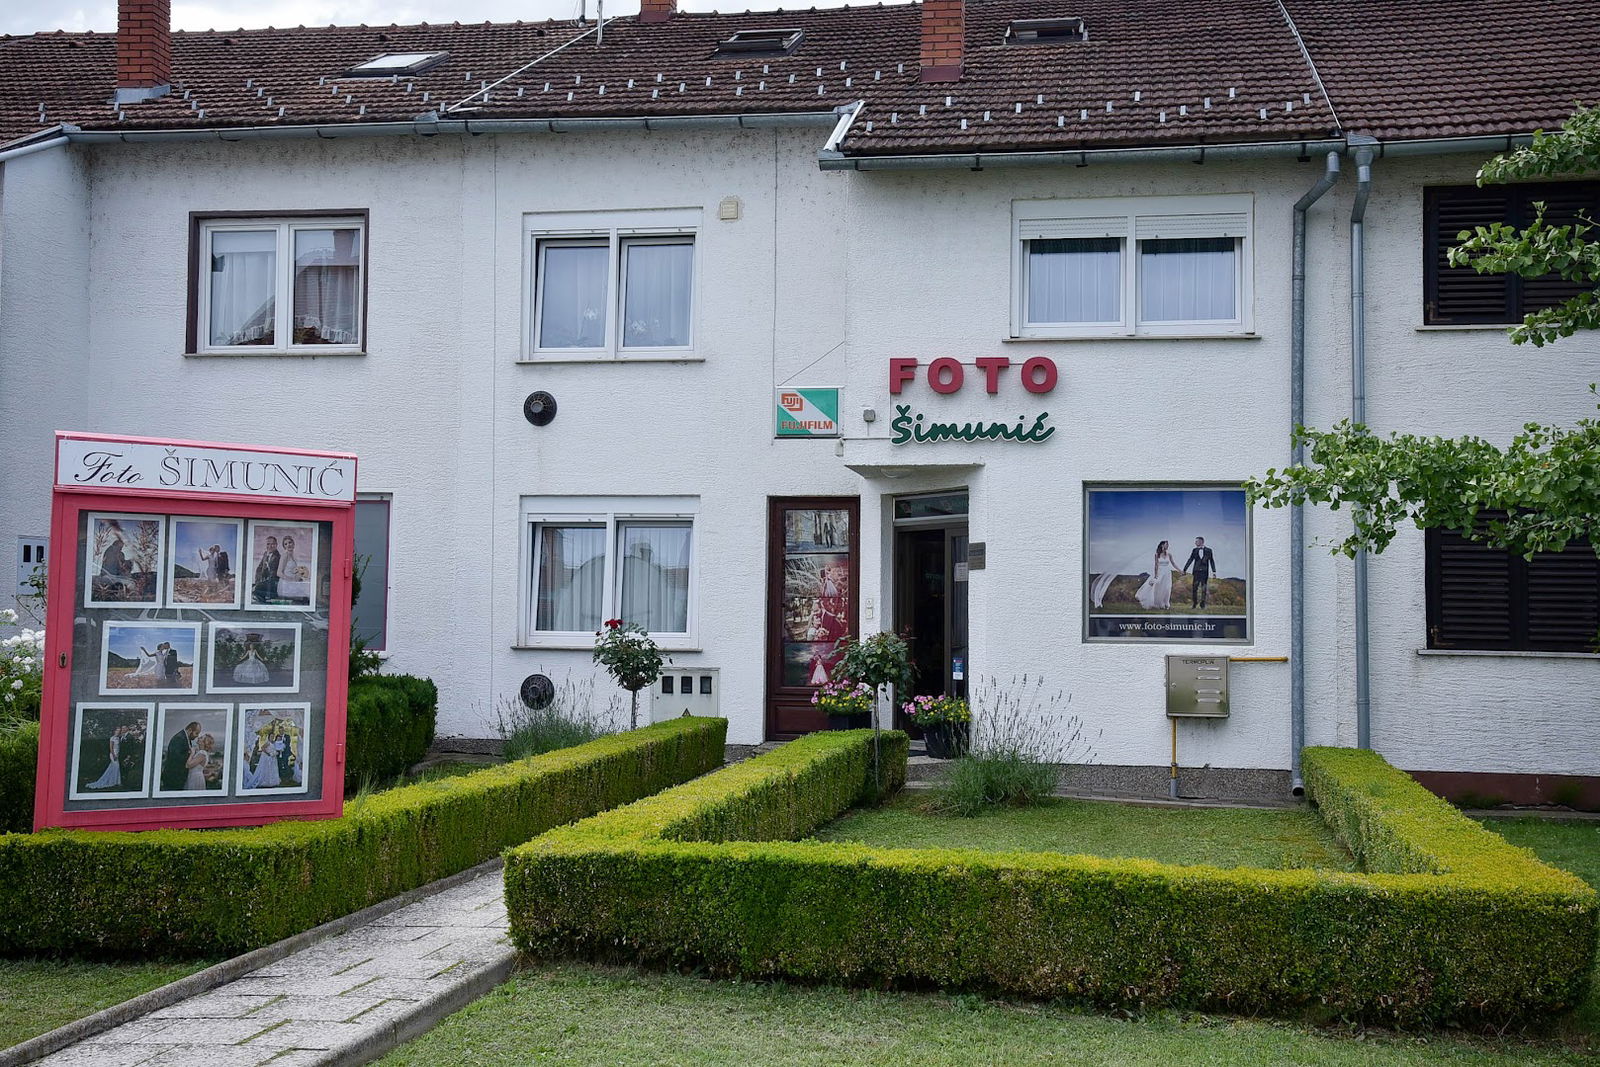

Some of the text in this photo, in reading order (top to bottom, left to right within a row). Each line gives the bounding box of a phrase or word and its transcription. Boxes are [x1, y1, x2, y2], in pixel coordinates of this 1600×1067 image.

[889, 356, 1058, 394] FOTO
[781, 420, 833, 430] FUJIFILM
[890, 404, 1056, 445] Šimunić
[74, 448, 344, 496] Foto ŠIMUNIĆ
[1119, 622, 1216, 631] www.foto-simunic.hr
